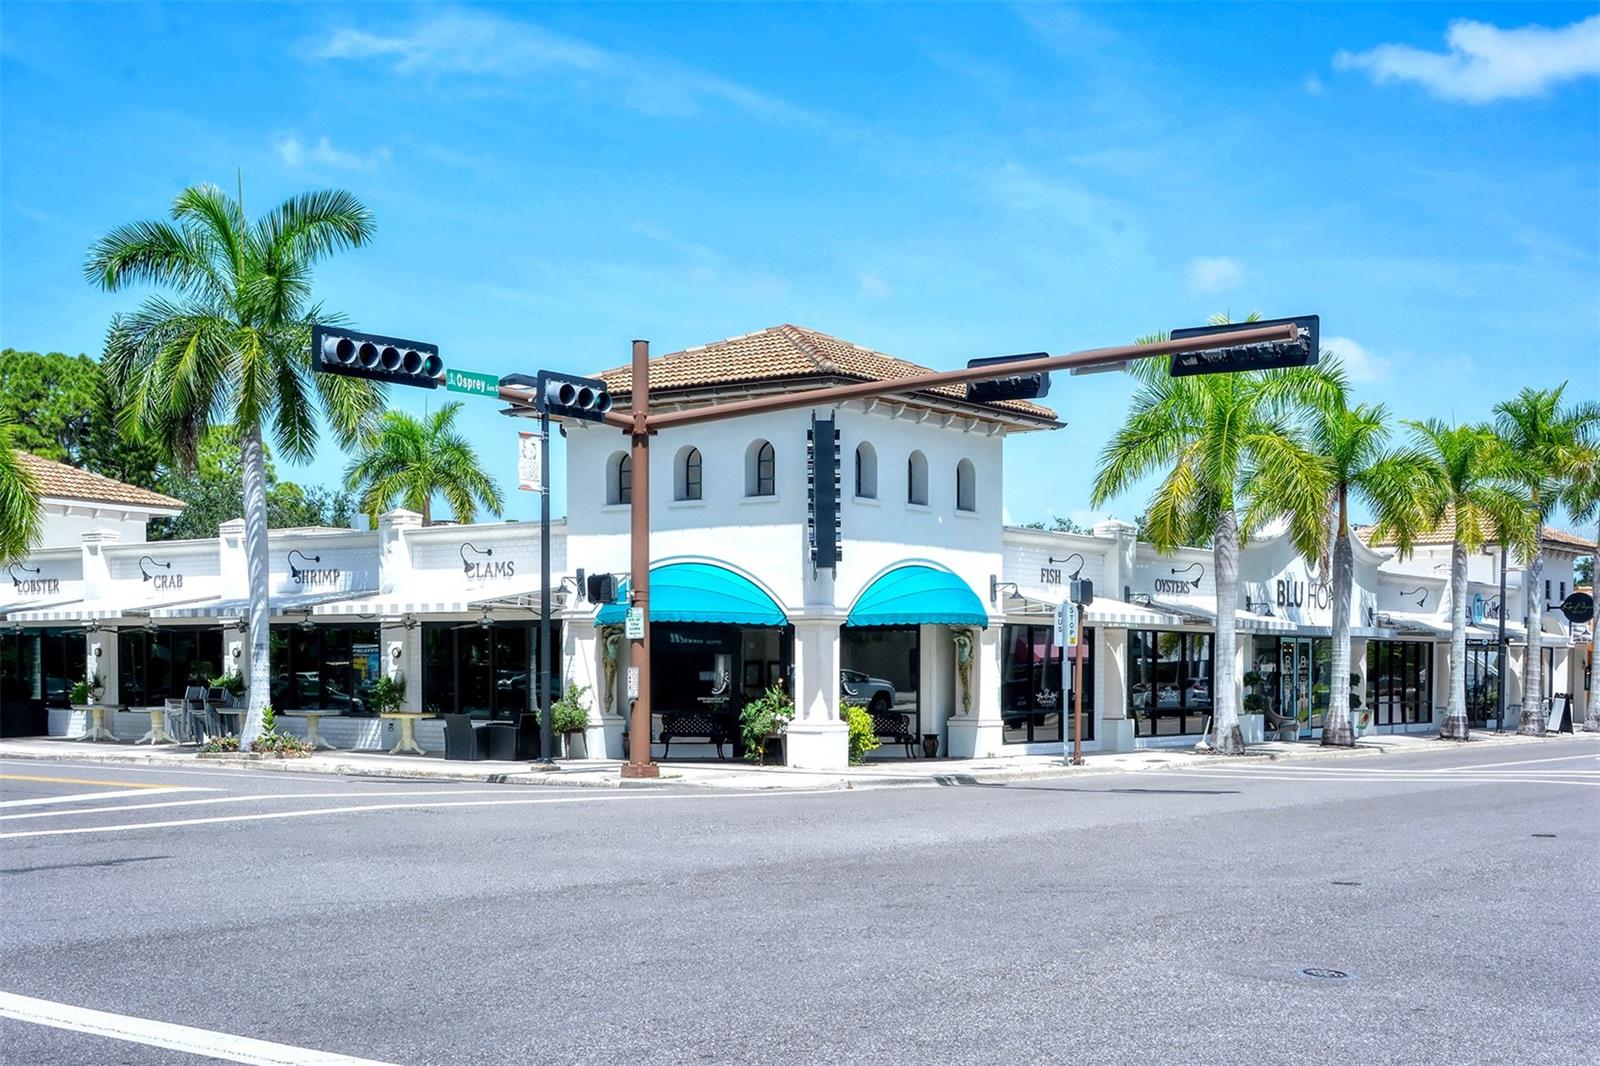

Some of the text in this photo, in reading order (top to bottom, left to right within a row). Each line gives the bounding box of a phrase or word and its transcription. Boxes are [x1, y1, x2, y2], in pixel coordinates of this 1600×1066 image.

[457, 373, 485, 393] Osprey
[294, 569, 340, 586] SHRIMP
[466, 561, 514, 578] CLAMS
[1040, 568, 1061, 584] FISH
[17, 579, 60, 593] LOBSTER
[153, 574, 183, 589] CRAB
[1154, 578, 1190, 594] OYSTERS
[1277, 579, 1303, 608] BLU
